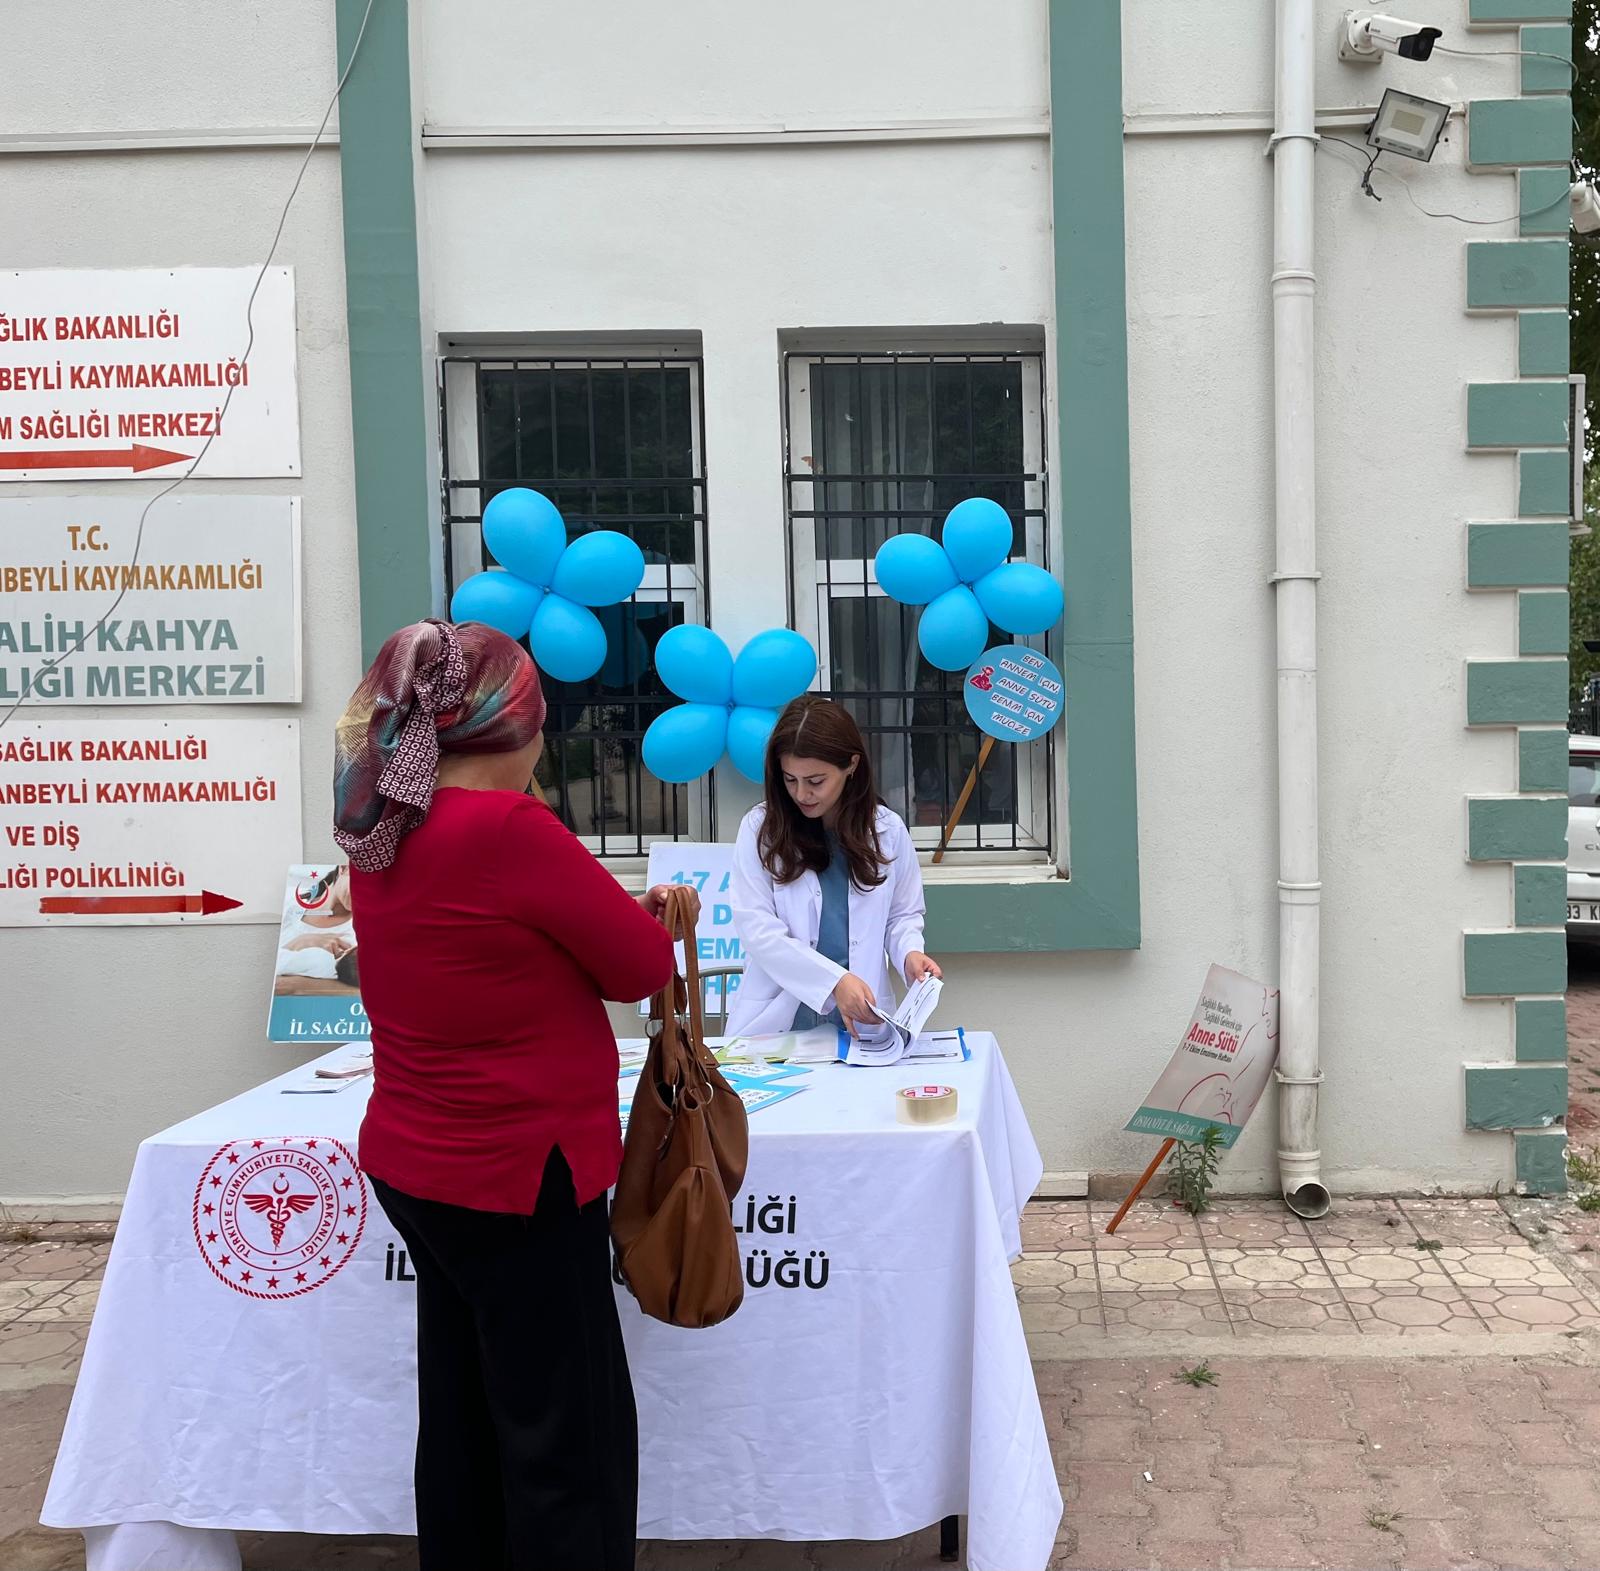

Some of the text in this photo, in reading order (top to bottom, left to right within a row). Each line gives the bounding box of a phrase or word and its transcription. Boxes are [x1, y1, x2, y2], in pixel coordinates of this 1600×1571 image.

[55, 308, 180, 341] BAKANLIĞI
[0, 357, 249, 391] BEYLİ KAYMAKAMLIĞI
[19, 409, 110, 440] SAĞLIĞI
[118, 407, 222, 438] MERKEZİ
[67, 525, 109, 551] T.C.
[0, 558, 263, 593] BEYLİ KAYMAKAMLIĞI
[0, 612, 239, 653] ALİH KAHYA
[86, 656, 265, 697] MERKEZİ
[1000, 660, 1037, 681] ANNEM
[1022, 655, 1043, 668] BEN
[998, 678, 1028, 695] ANNE
[0, 735, 208, 762] AĞLIK BAKANLIĞI
[96, 776, 276, 803] KAYMAKAMLIĞI
[5, 821, 80, 851] VE DİŞ
[290, 1018, 307, 1035] İL
[1187, 1022, 1240, 1053] Anne Sütü
[224, 1153, 335, 1258] TÜRKİYE CUMHURİYETİ SAĞLIK BAKANLIĞI
[385, 1242, 416, 1281] İL
